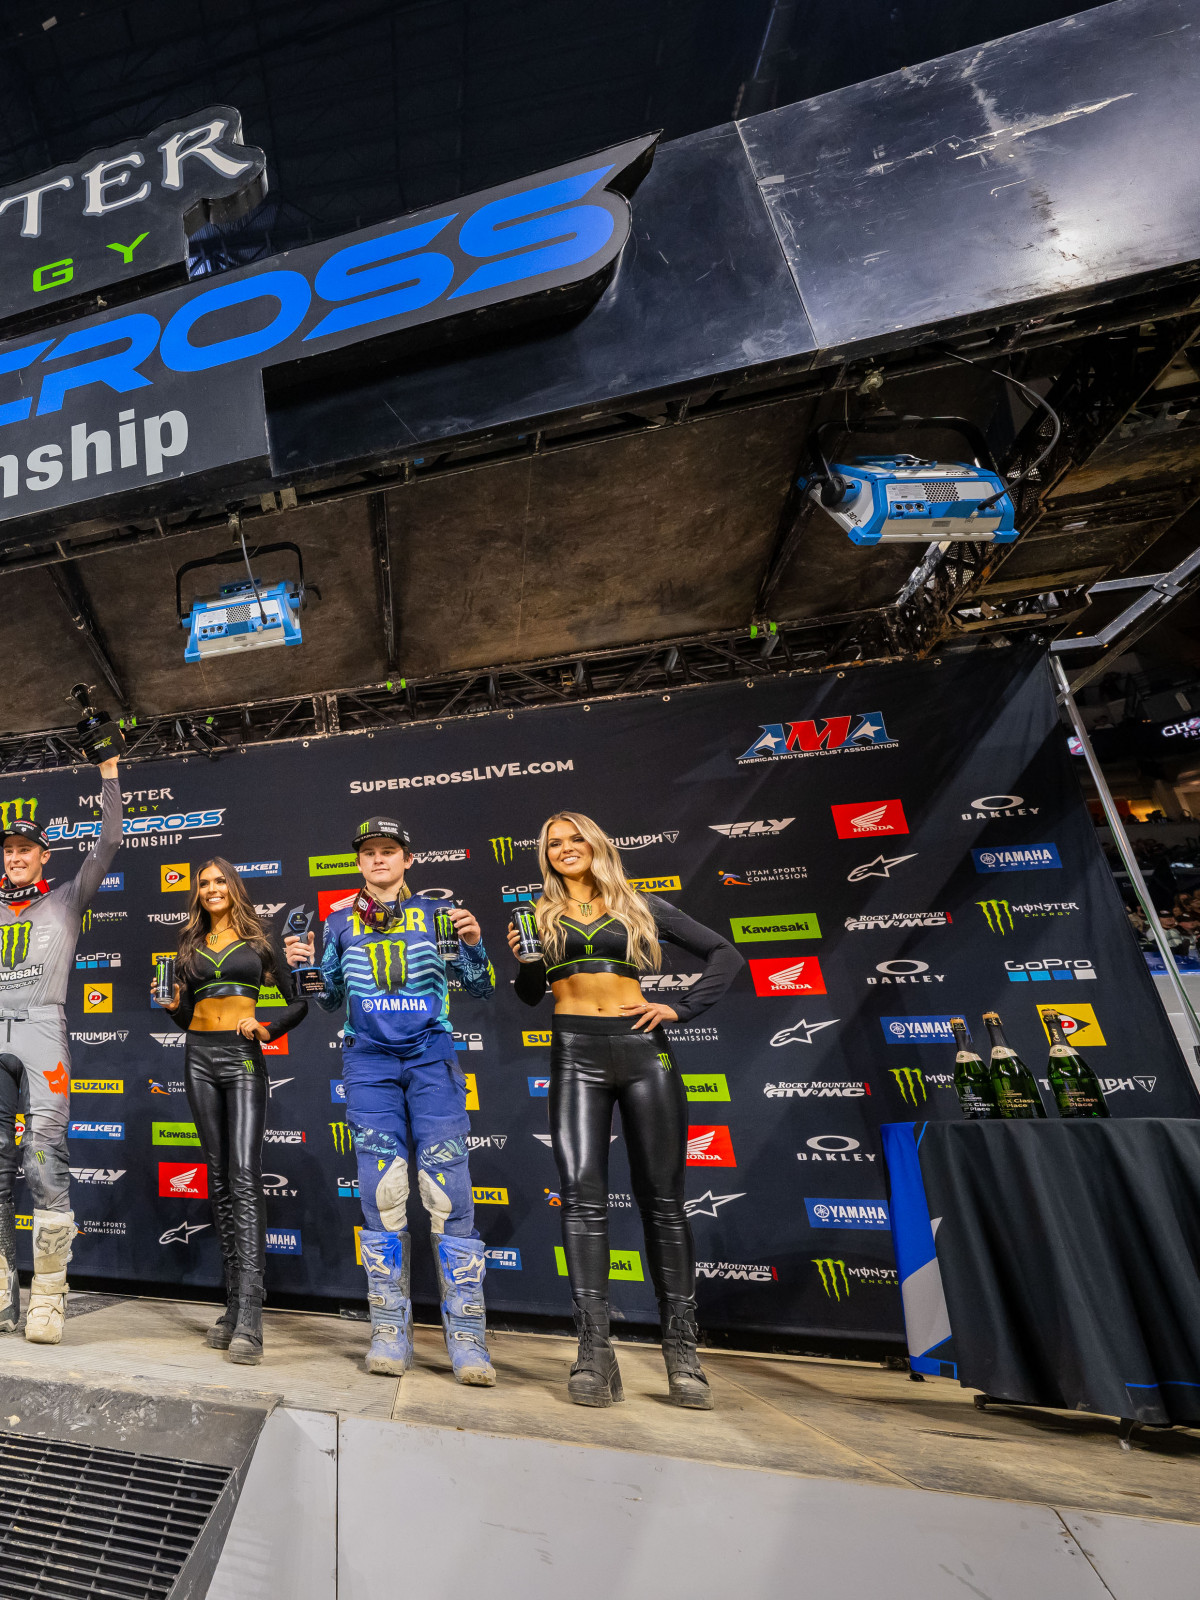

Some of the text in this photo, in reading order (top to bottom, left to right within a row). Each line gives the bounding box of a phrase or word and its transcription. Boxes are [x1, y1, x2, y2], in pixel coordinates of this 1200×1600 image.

[736, 711, 899, 760] AMA
[738, 743, 899, 765] AMERICAN MOTORCYCLIST ASSOCIATION
[350, 760, 574, 794] SUPERCROSSLIVE.COM
[79, 787, 174, 808] MOSTER
[94, 804, 159, 816] ERGY
[962, 807, 1039, 821] OAKLEY
[50, 816, 68, 826] AMA
[853, 825, 894, 833] HONDA
[729, 831, 780, 839] RACING
[608, 834, 662, 849] RIUMPH
[995, 849, 1053, 862] YAMAHA
[233, 863, 279, 872] ALKEN
[773, 866, 807, 874] SPORTS
[747, 873, 807, 882] COMMISSION
[1012, 901, 1079, 913] MONSTER
[892, 912, 944, 920] MOUNTAIN
[742, 922, 809, 935] Kawasaki
[76, 953, 121, 961] GoPro
[1005, 959, 1092, 971] GoPro
[867, 975, 945, 985] OAKLEY
[374, 999, 427, 1011] YAMAHA
[70, 1032, 117, 1044] TRIUMPH
[74, 1082, 119, 1091] SUZUKI
[684, 1083, 718, 1093] asaki
[72, 1123, 122, 1132] FALKEN
[160, 1130, 199, 1139] Kawasa
[797, 1153, 876, 1162] OAKLEY
[473, 1191, 501, 1200] UKI
[830, 1206, 887, 1220] YAMAHA
[718, 1262, 770, 1272] MOUNTAIN
